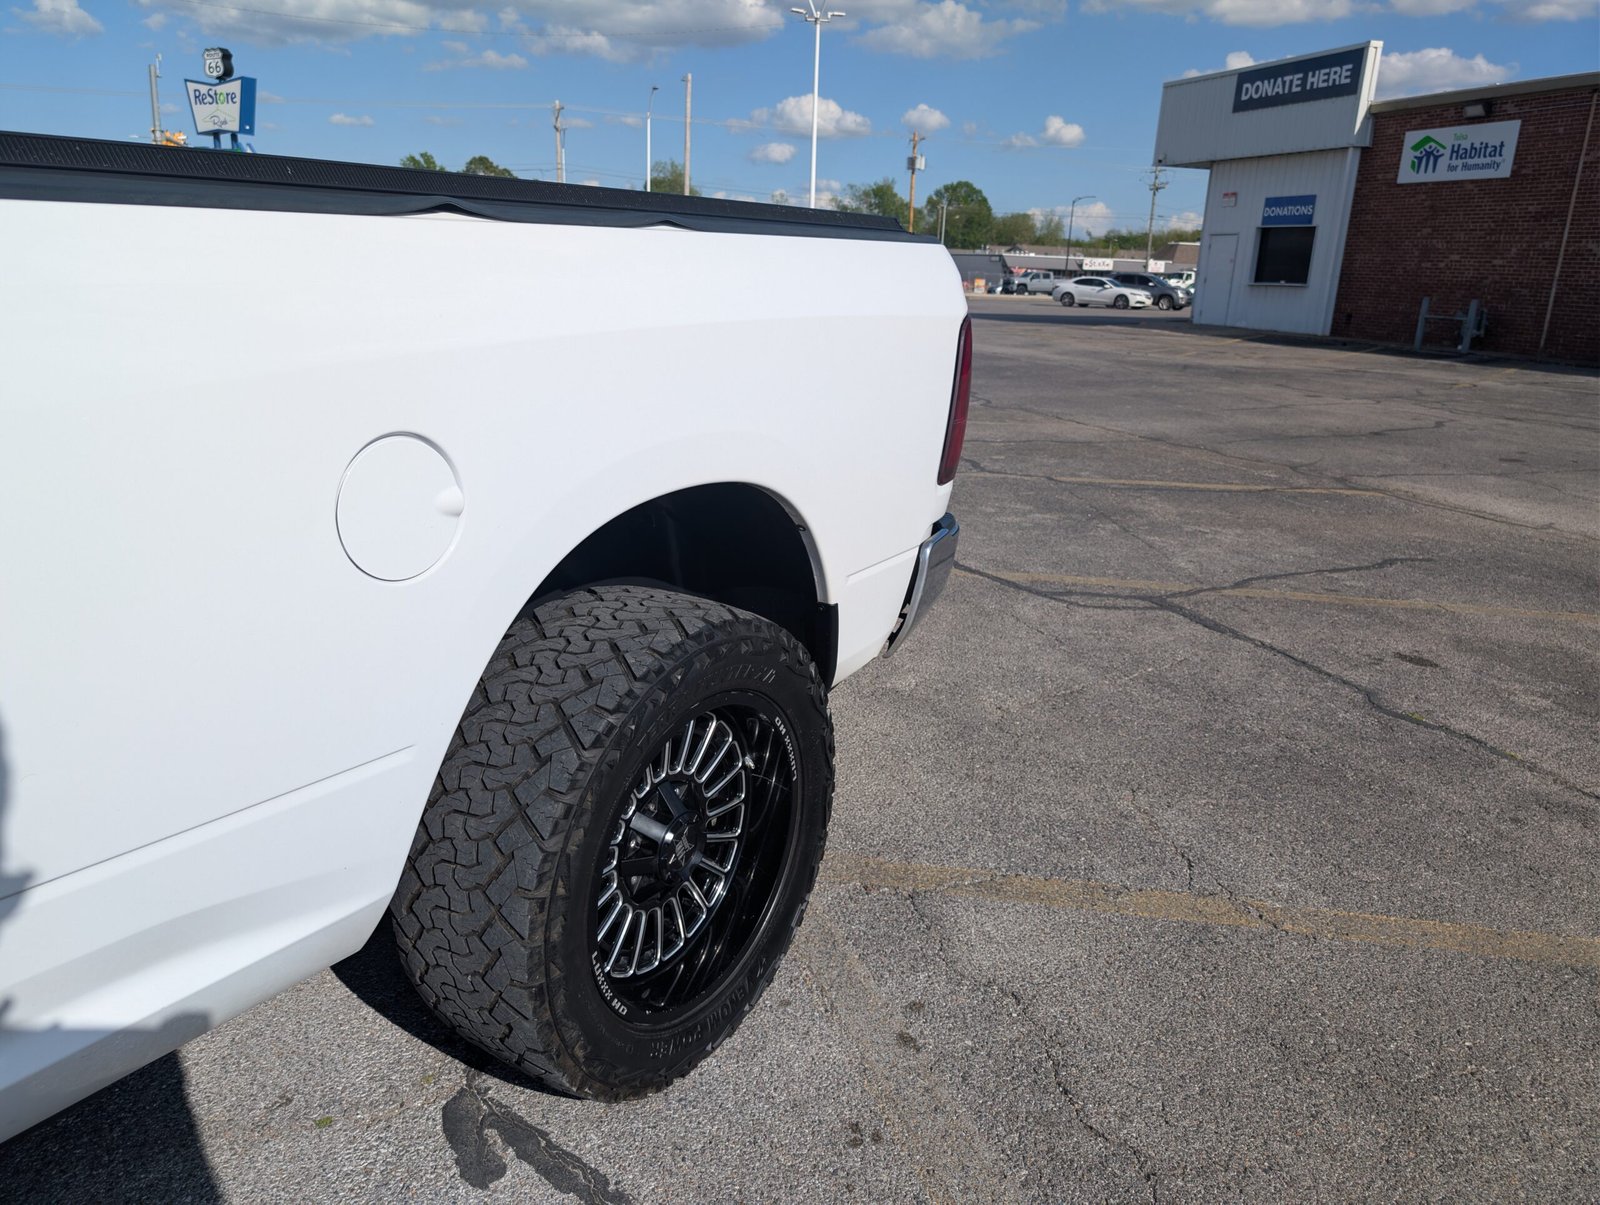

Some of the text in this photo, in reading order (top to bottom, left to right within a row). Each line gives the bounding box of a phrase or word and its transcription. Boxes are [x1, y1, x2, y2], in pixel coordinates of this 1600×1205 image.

[208, 61, 221, 74] 66
[1241, 64, 1353, 101] DONATE HERE
[193, 88, 237, 105] ReStore
[1449, 141, 1505, 161] Habitat
[1447, 160, 1502, 172] for Humanity
[1264, 205, 1313, 216] DONATIONS
[611, 998, 628, 1015] HD
